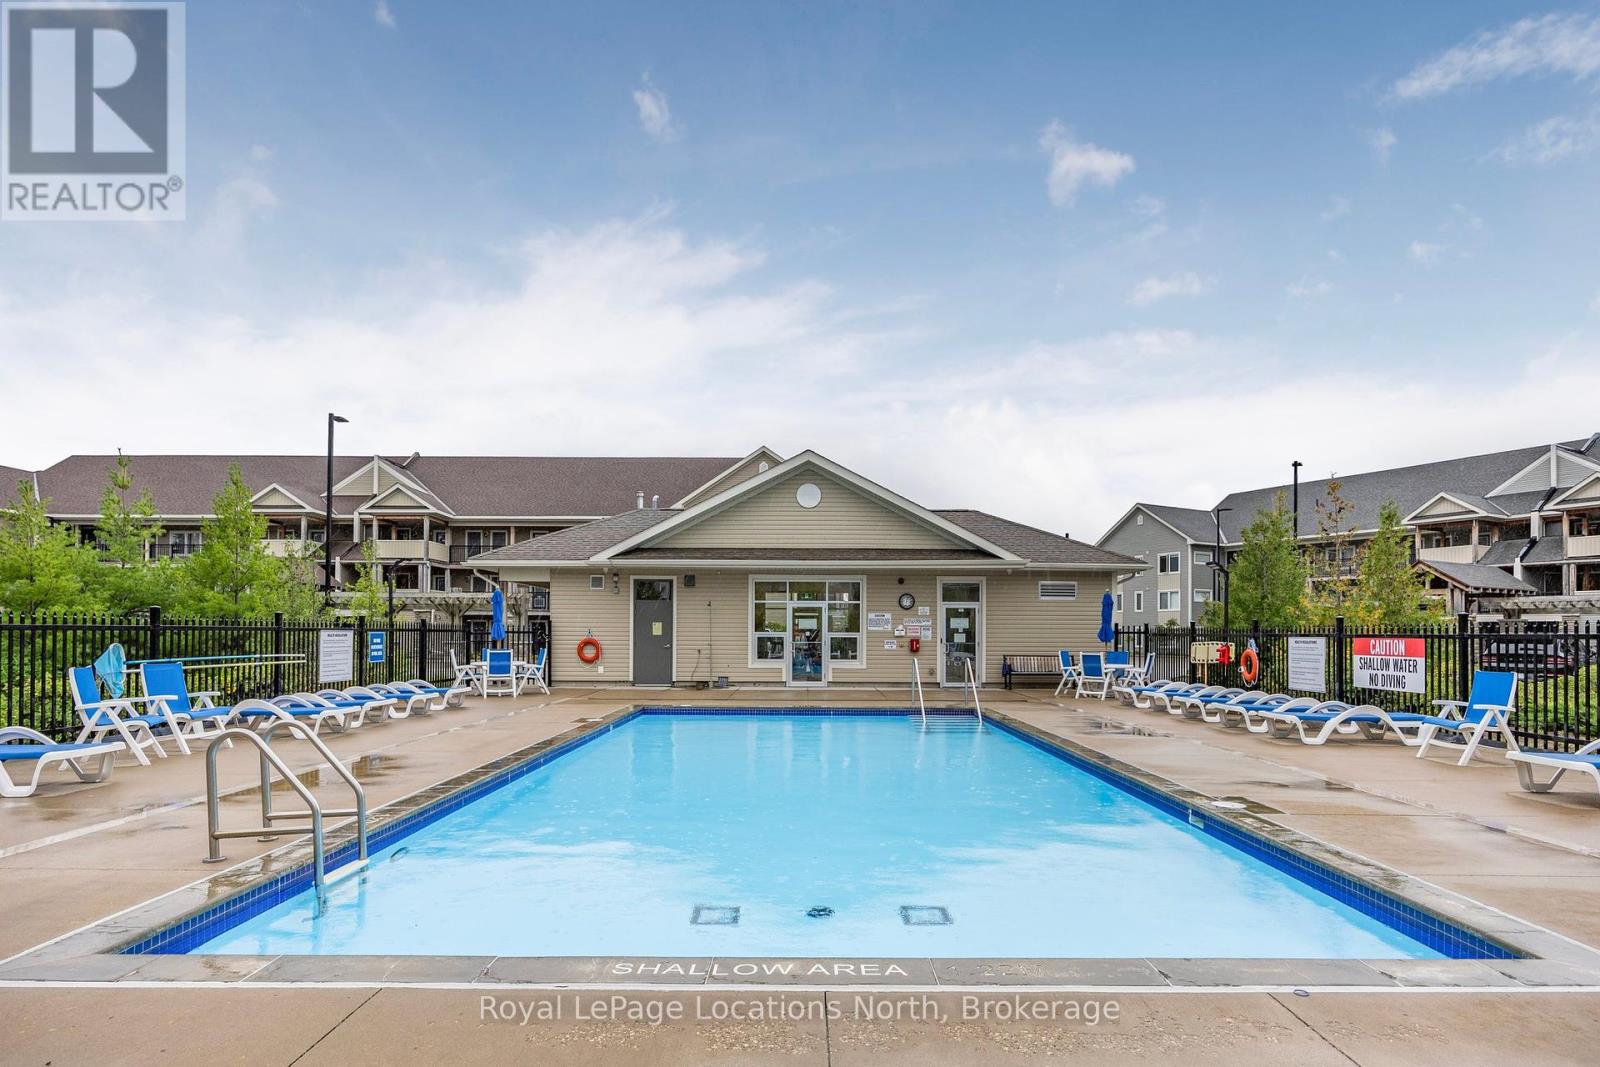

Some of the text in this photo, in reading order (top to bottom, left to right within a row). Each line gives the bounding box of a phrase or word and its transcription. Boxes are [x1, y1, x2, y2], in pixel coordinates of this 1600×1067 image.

[1370, 639, 1405, 656] CAUTION
[1359, 657, 1418, 674] SHALLOW WATER
[1369, 673, 1406, 690] NO DIVING
[612, 963, 908, 977] SHALLOW AREA
